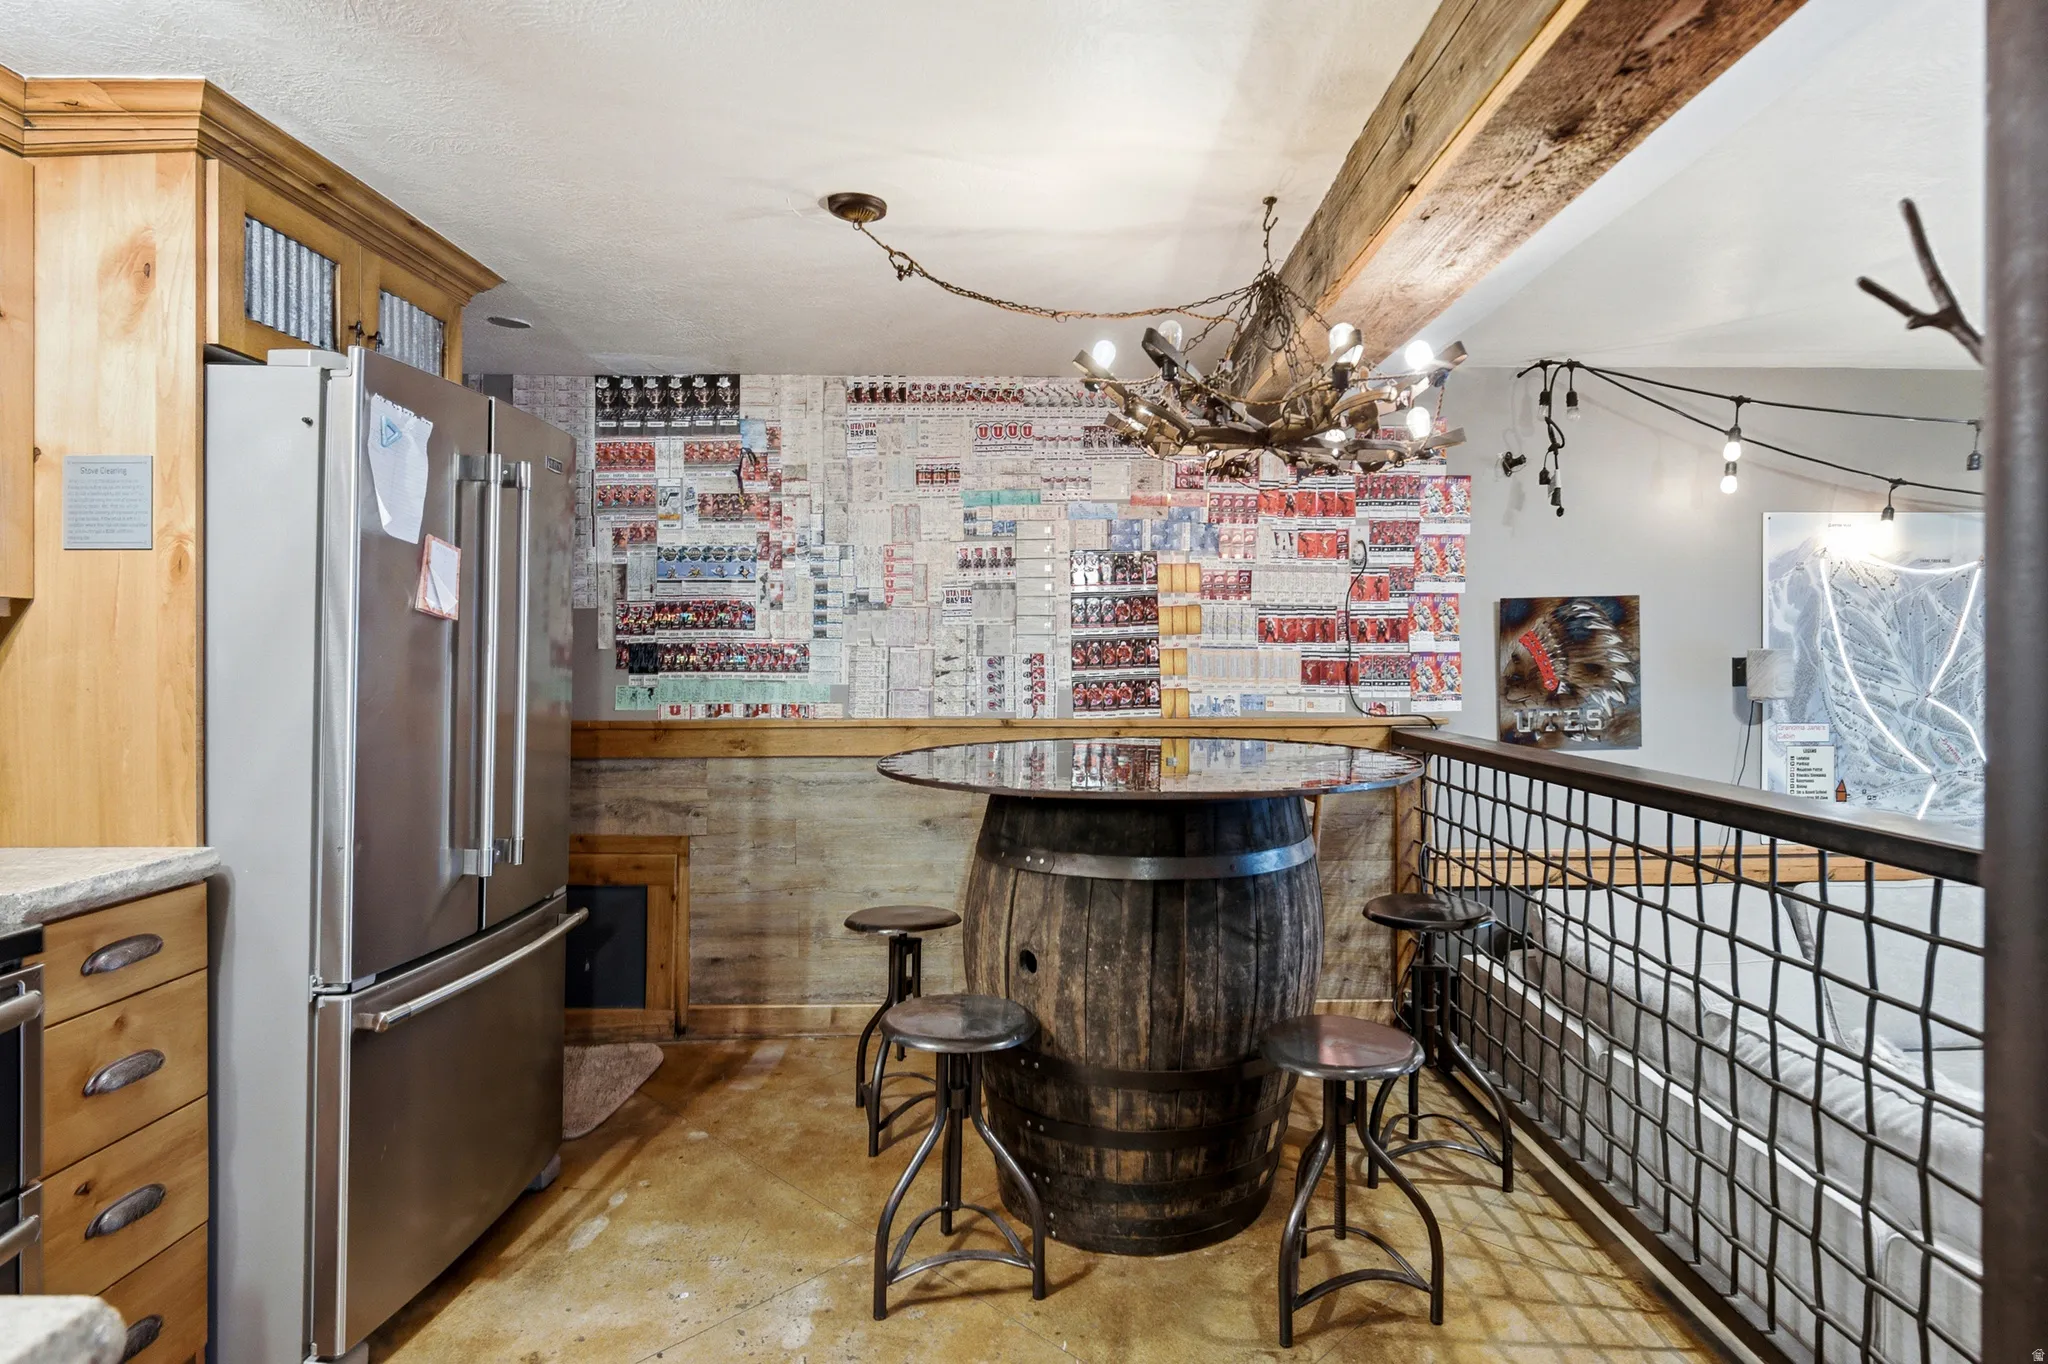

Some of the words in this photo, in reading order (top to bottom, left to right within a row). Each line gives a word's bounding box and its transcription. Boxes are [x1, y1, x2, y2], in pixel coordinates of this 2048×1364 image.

[80, 466, 98, 474] Stove
[100, 466, 128, 476] Cleaning
[669, 705, 681, 715] U
[1513, 709, 1605, 732] UTES
